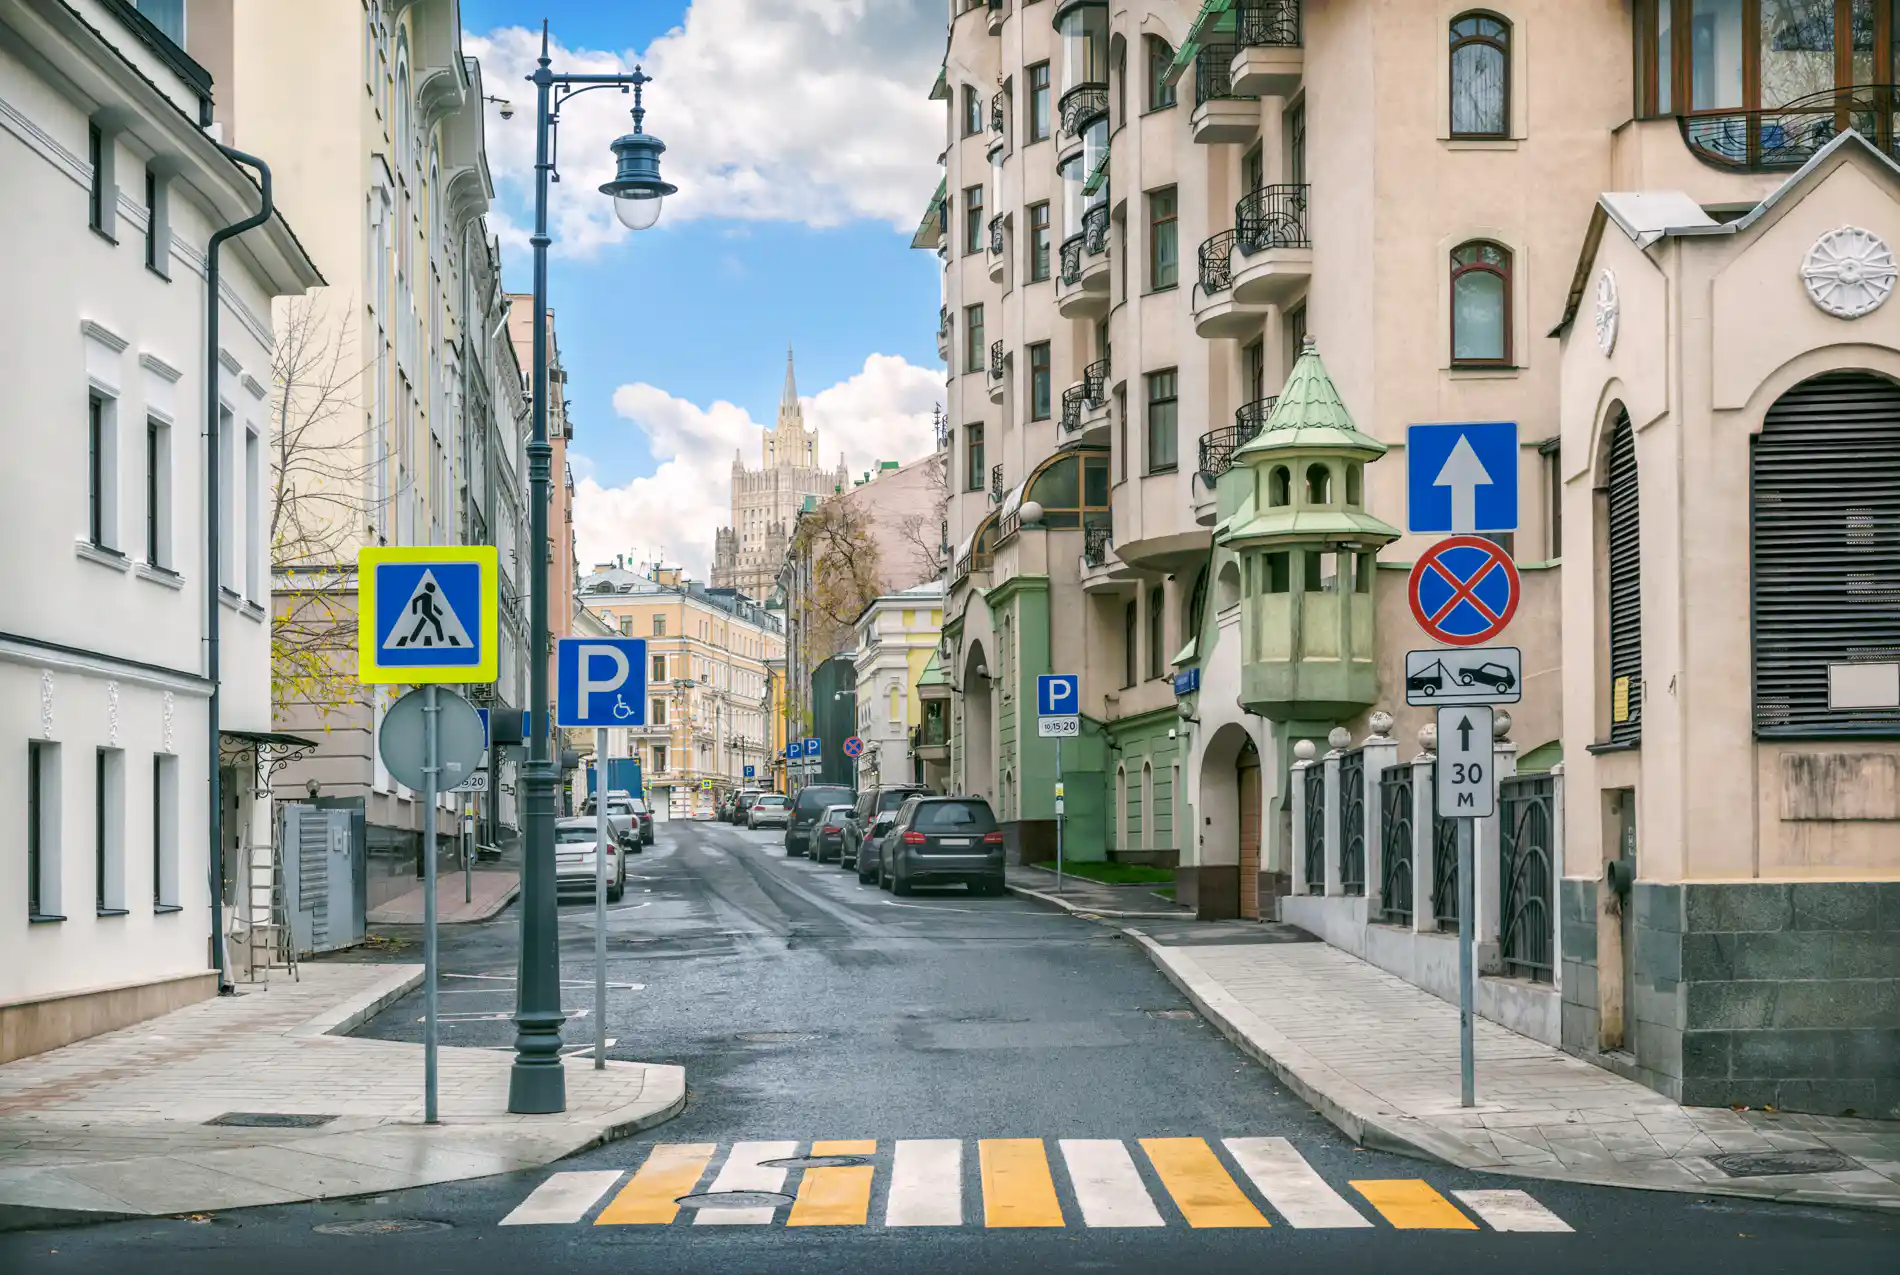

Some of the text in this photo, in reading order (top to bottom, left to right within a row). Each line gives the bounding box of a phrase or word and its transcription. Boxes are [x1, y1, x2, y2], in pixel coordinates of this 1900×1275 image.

[578, 645, 629, 719] P
[1049, 679, 1071, 711] P
[1053, 722, 1061, 730] 15
[1063, 721, 1076, 731] 20
[790, 744, 799, 757] P
[808, 740, 818, 754] P
[746, 766, 752, 776] P
[1451, 763, 1483, 784] 30
[471, 777, 484, 786] 20
